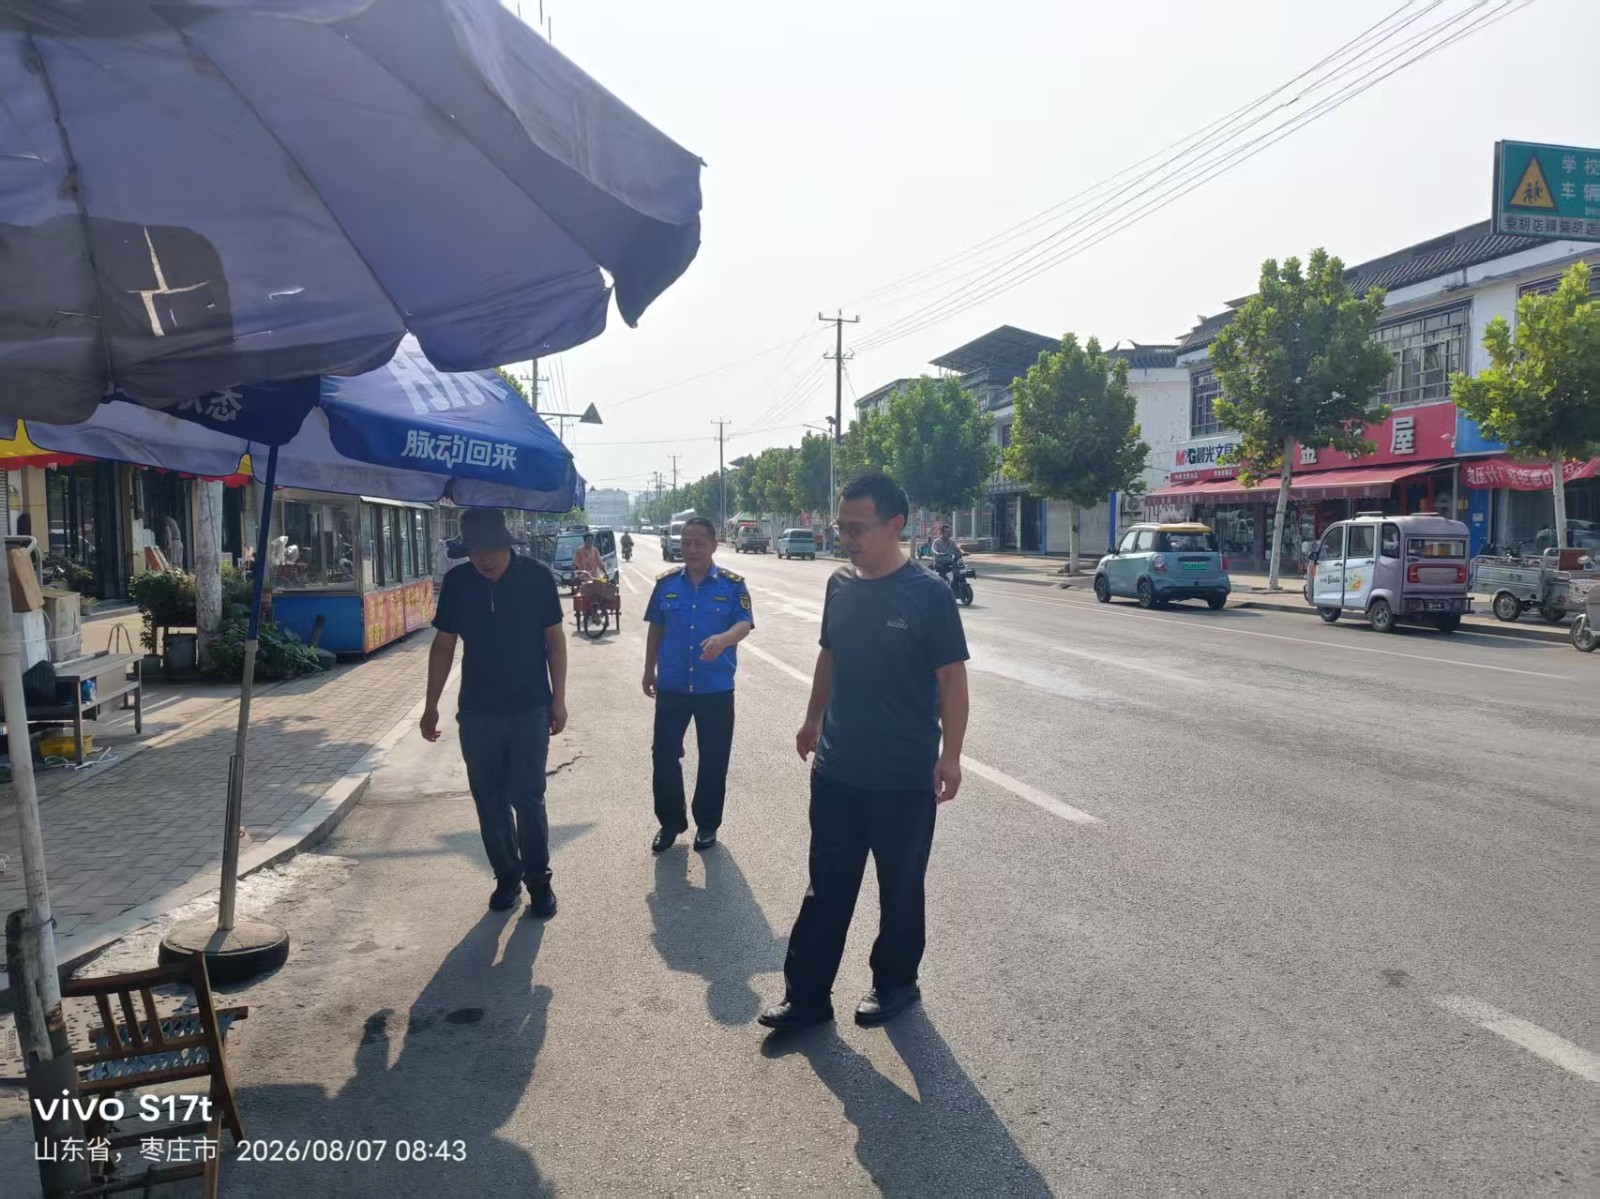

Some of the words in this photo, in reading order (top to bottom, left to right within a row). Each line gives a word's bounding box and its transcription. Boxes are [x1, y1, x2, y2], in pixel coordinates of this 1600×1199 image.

[1562, 155, 1600, 176] 学校
[401, 429, 518, 470] 脉动回来
[1391, 416, 1415, 455] 屋
